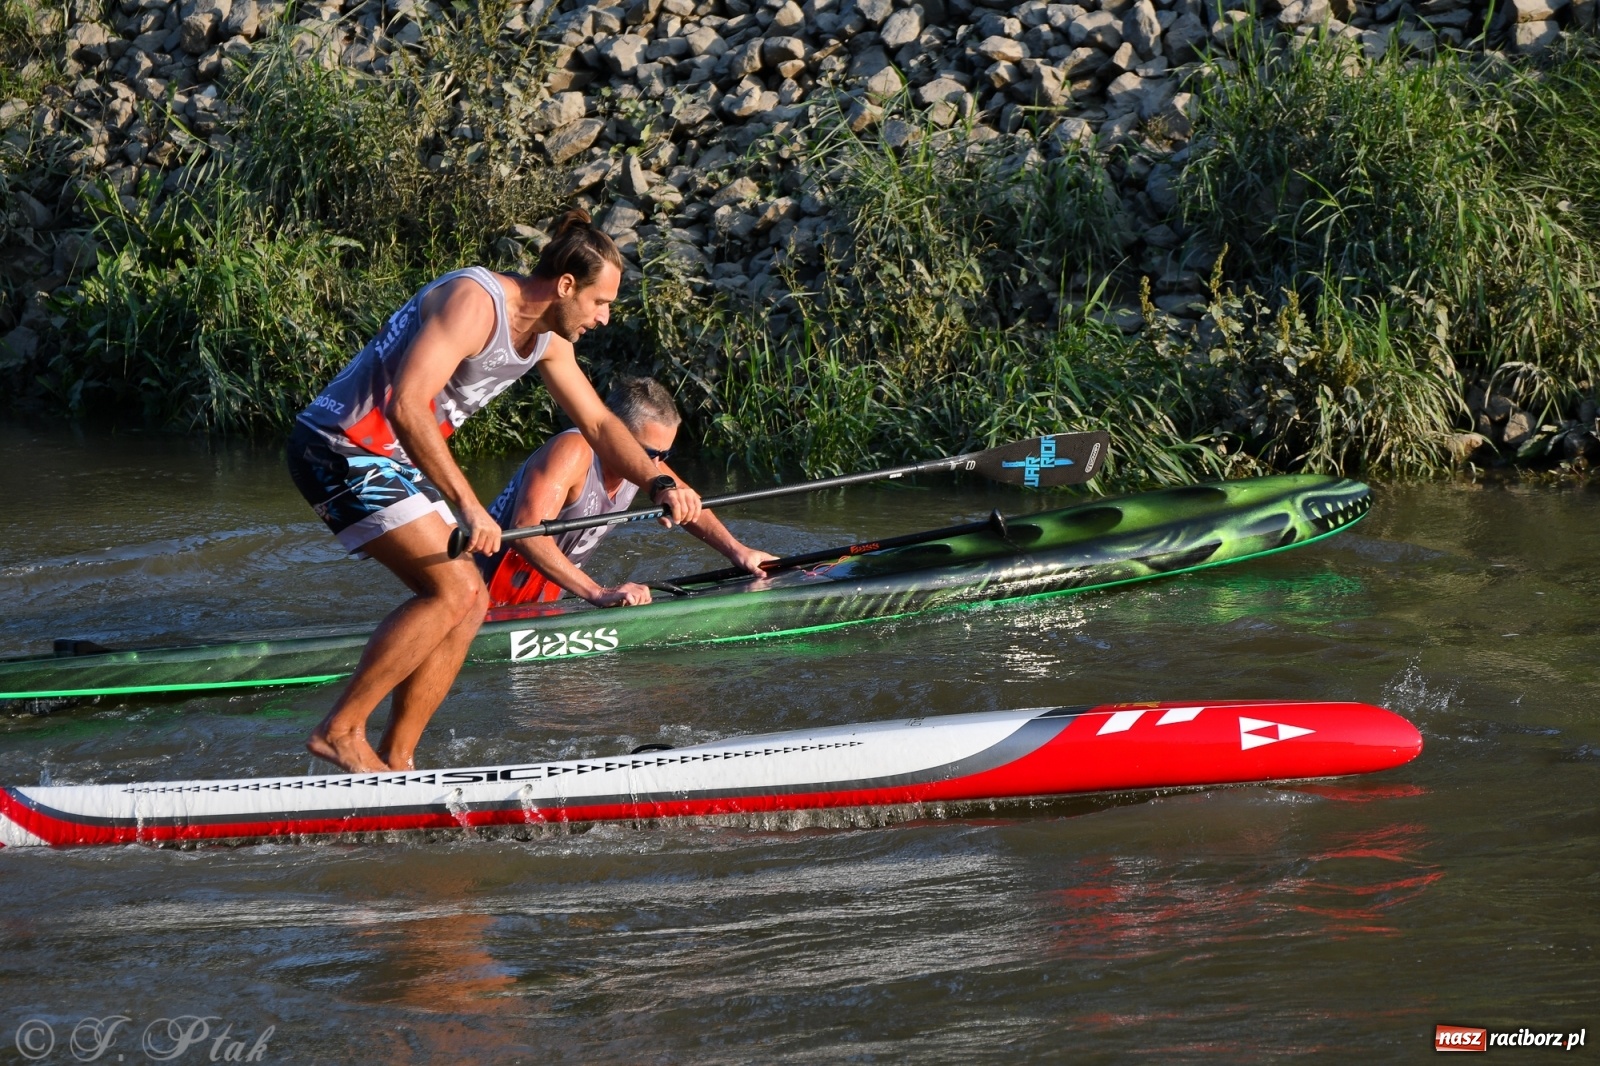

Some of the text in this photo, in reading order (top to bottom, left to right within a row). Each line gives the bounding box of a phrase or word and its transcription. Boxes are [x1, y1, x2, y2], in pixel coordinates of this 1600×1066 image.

[312, 393, 345, 415] BÓRZ
[510, 627, 619, 661] Bass
[441, 766, 542, 785] SIC
